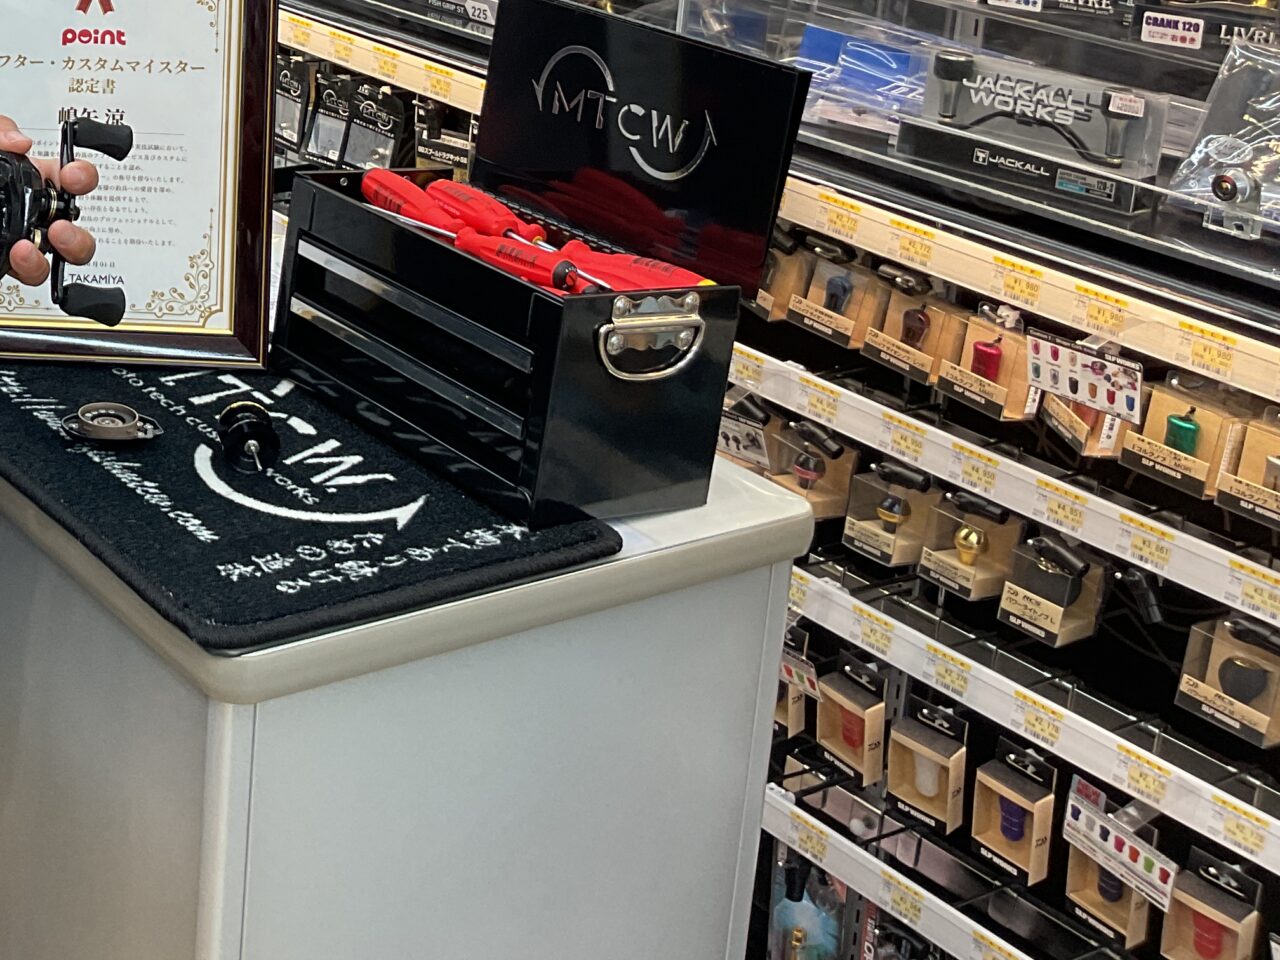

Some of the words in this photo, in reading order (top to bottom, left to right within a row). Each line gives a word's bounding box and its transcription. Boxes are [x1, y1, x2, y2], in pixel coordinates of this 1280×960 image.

[440, 0, 456, 11] GRIP
[455, 4, 465, 14] ST
[470, 4, 488, 21] 225
[1144, 15, 1180, 30] CRANK
[1181, 19, 1200, 33] 120
[61, 28, 127, 46] point
[68, 78, 117, 95] 認定書
[962, 74, 1085, 112] JACKALL
[970, 88, 1076, 125] WORKS
[988, 154, 1051, 177] JACKALL
[1013, 276, 1040, 292] ¥1,980
[1201, 344, 1233, 362] ¥1,980
[141, 385, 187, 417] tech
